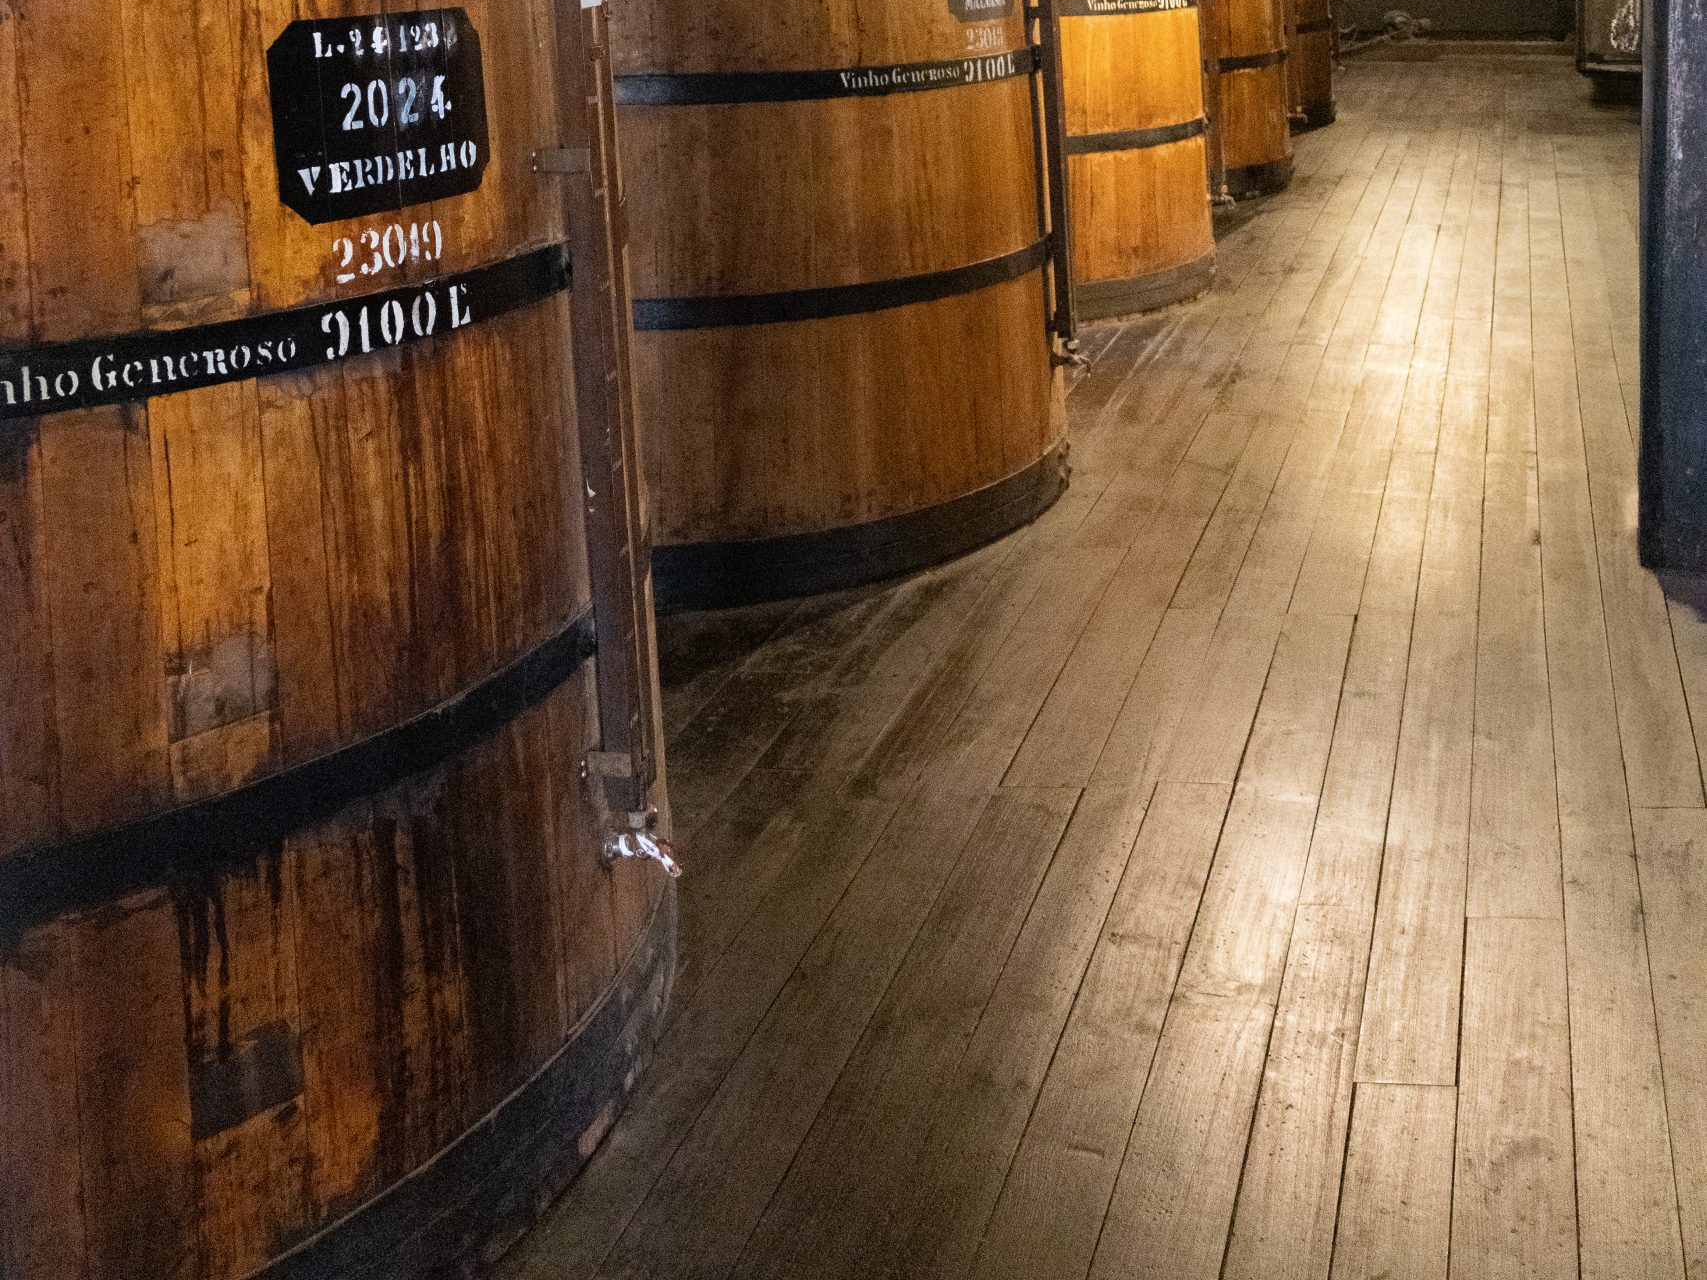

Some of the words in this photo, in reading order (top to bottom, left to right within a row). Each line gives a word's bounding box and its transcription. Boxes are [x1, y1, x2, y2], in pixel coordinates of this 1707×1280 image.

[1087, 0, 1117, 11] Vinho
[340, 74, 452, 131] 2024
[840, 70, 889, 89] Vinho
[297, 140, 477, 196] VERDELHO
[332, 220, 442, 284] 23019
